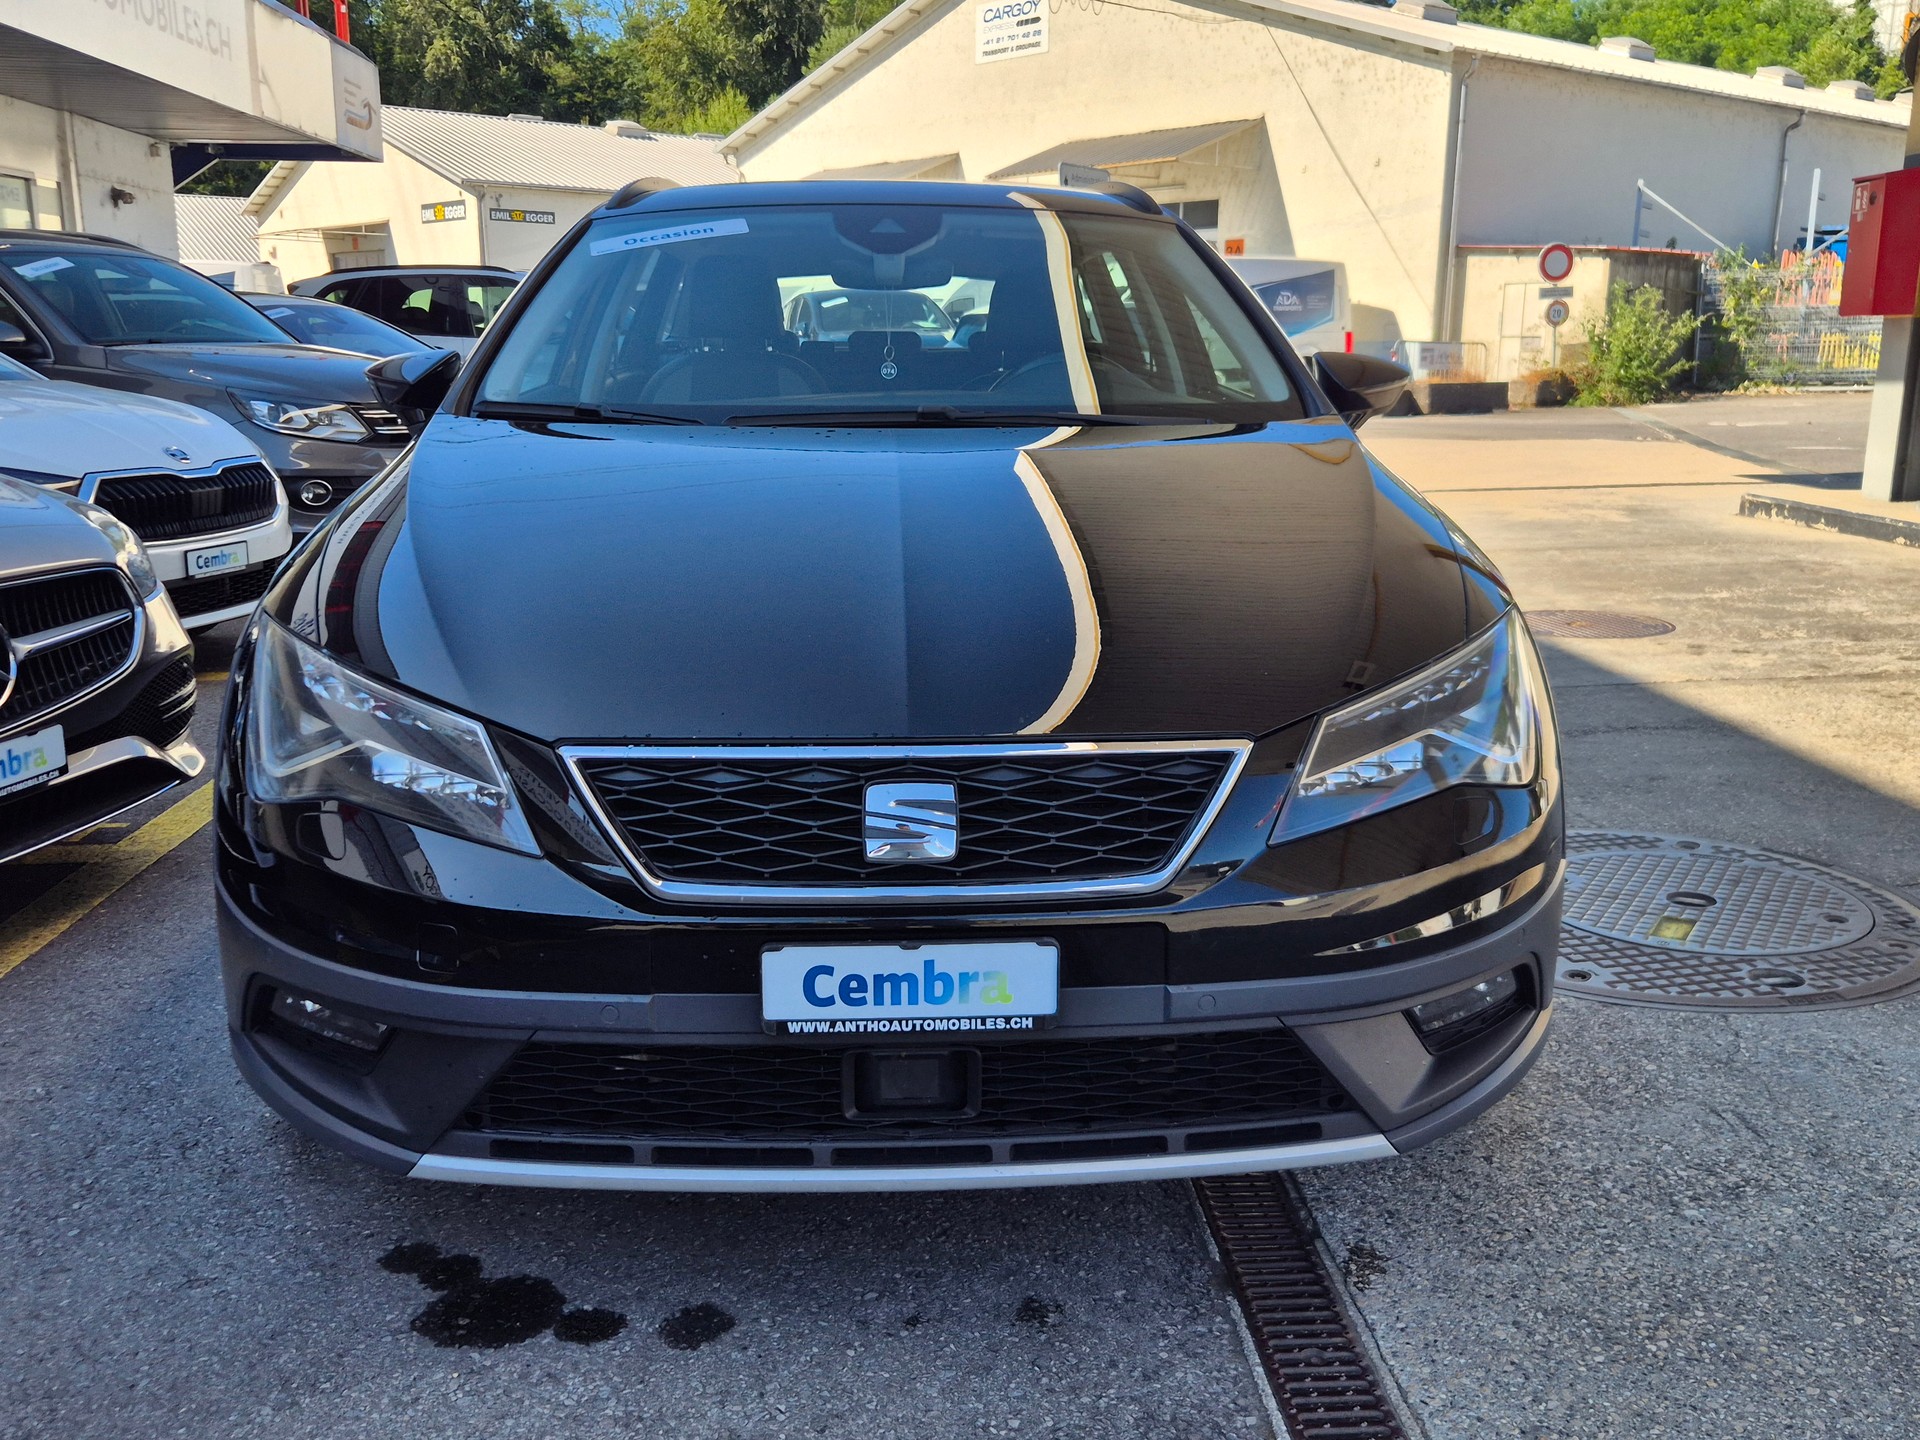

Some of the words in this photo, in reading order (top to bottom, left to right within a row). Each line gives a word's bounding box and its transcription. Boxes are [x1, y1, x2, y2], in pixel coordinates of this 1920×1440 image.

[983, 0, 1041, 23] CARGOY
[104, 0, 232, 61] OBILES.CH
[982, 47, 1009, 57] TRANSPORT
[422, 206, 436, 221] EMIL
[445, 204, 466, 219] EGGER
[491, 211, 511, 220] EMIL
[525, 213, 554, 223] EGGER
[624, 226, 714, 246] Occasion
[1552, 308, 1562, 319] 20
[196, 550, 240, 570] Cembra
[802, 959, 1014, 1008] Cembra
[787, 1017, 1033, 1034] WWW.ANTHOAUTOMOBILES.CH
